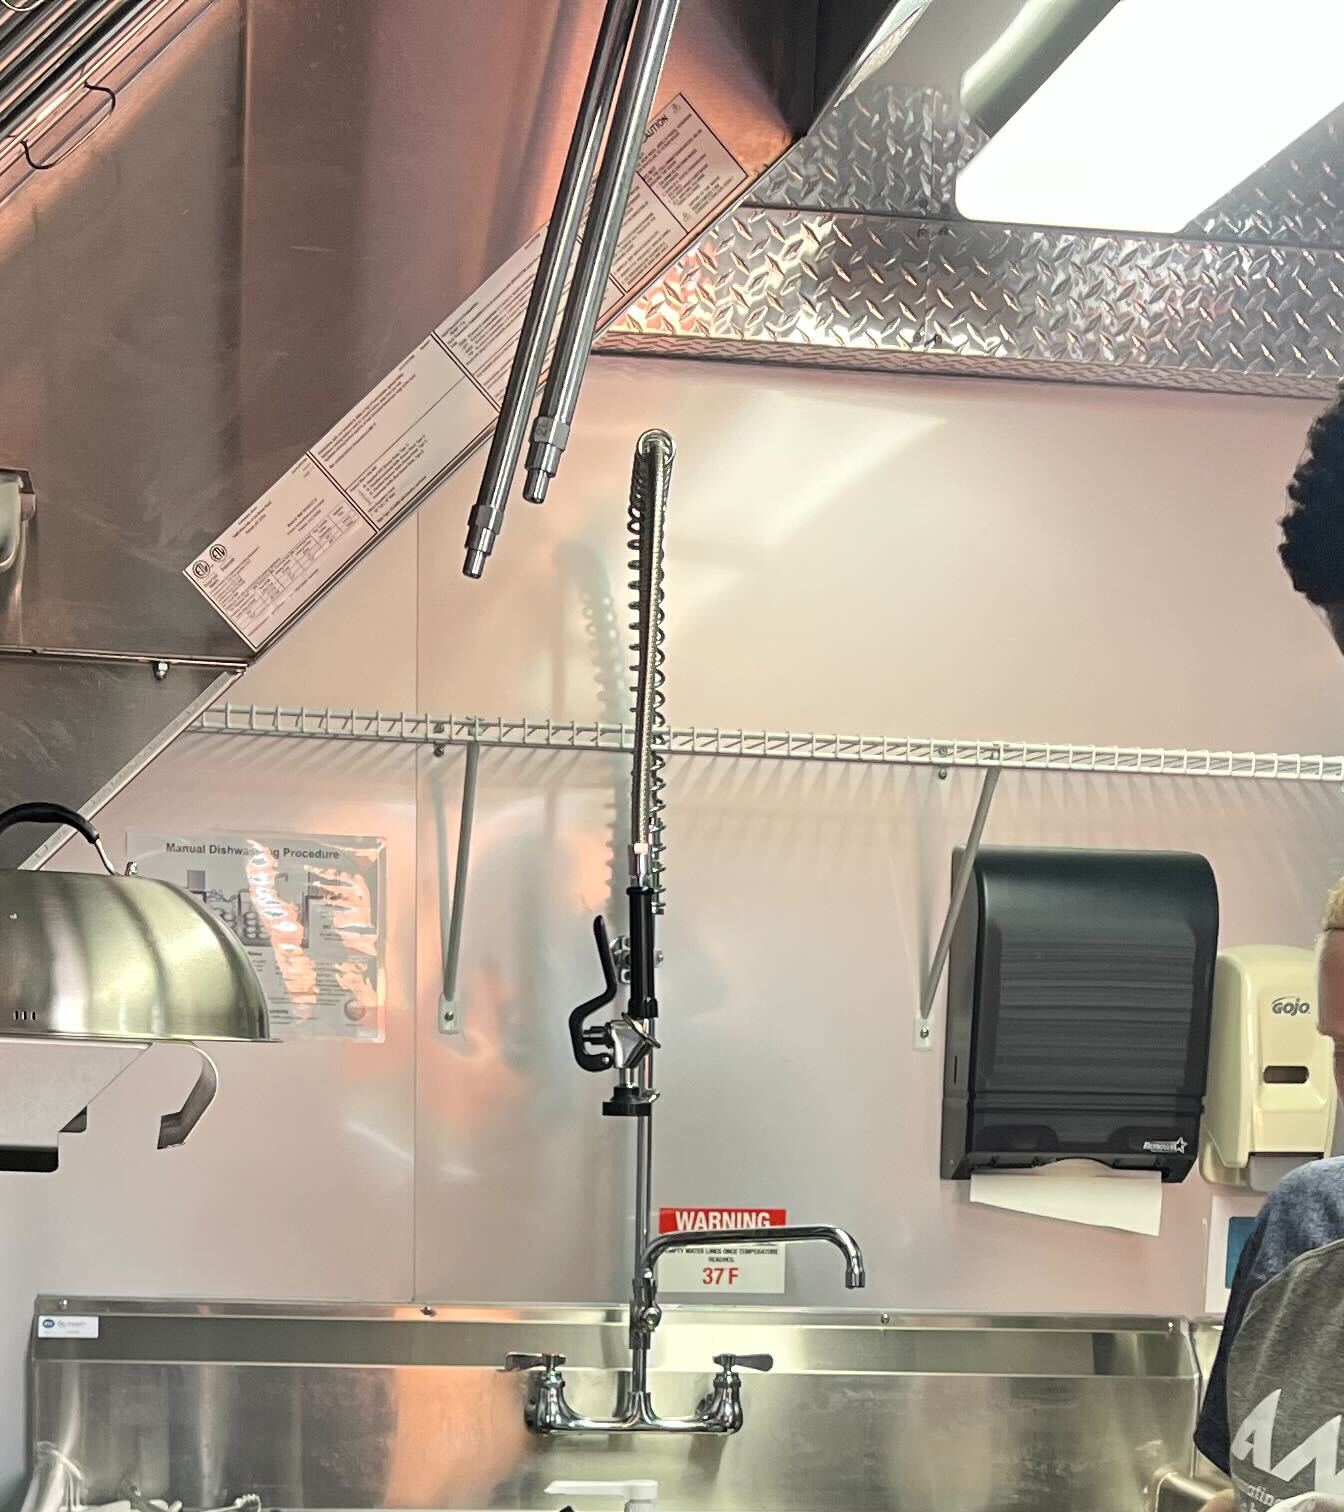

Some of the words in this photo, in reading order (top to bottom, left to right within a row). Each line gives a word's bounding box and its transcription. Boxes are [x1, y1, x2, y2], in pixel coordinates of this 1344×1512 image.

[166, 842, 206, 854] Manual
[283, 847, 340, 860] Procedure
[675, 1211, 771, 1230] WARNING
